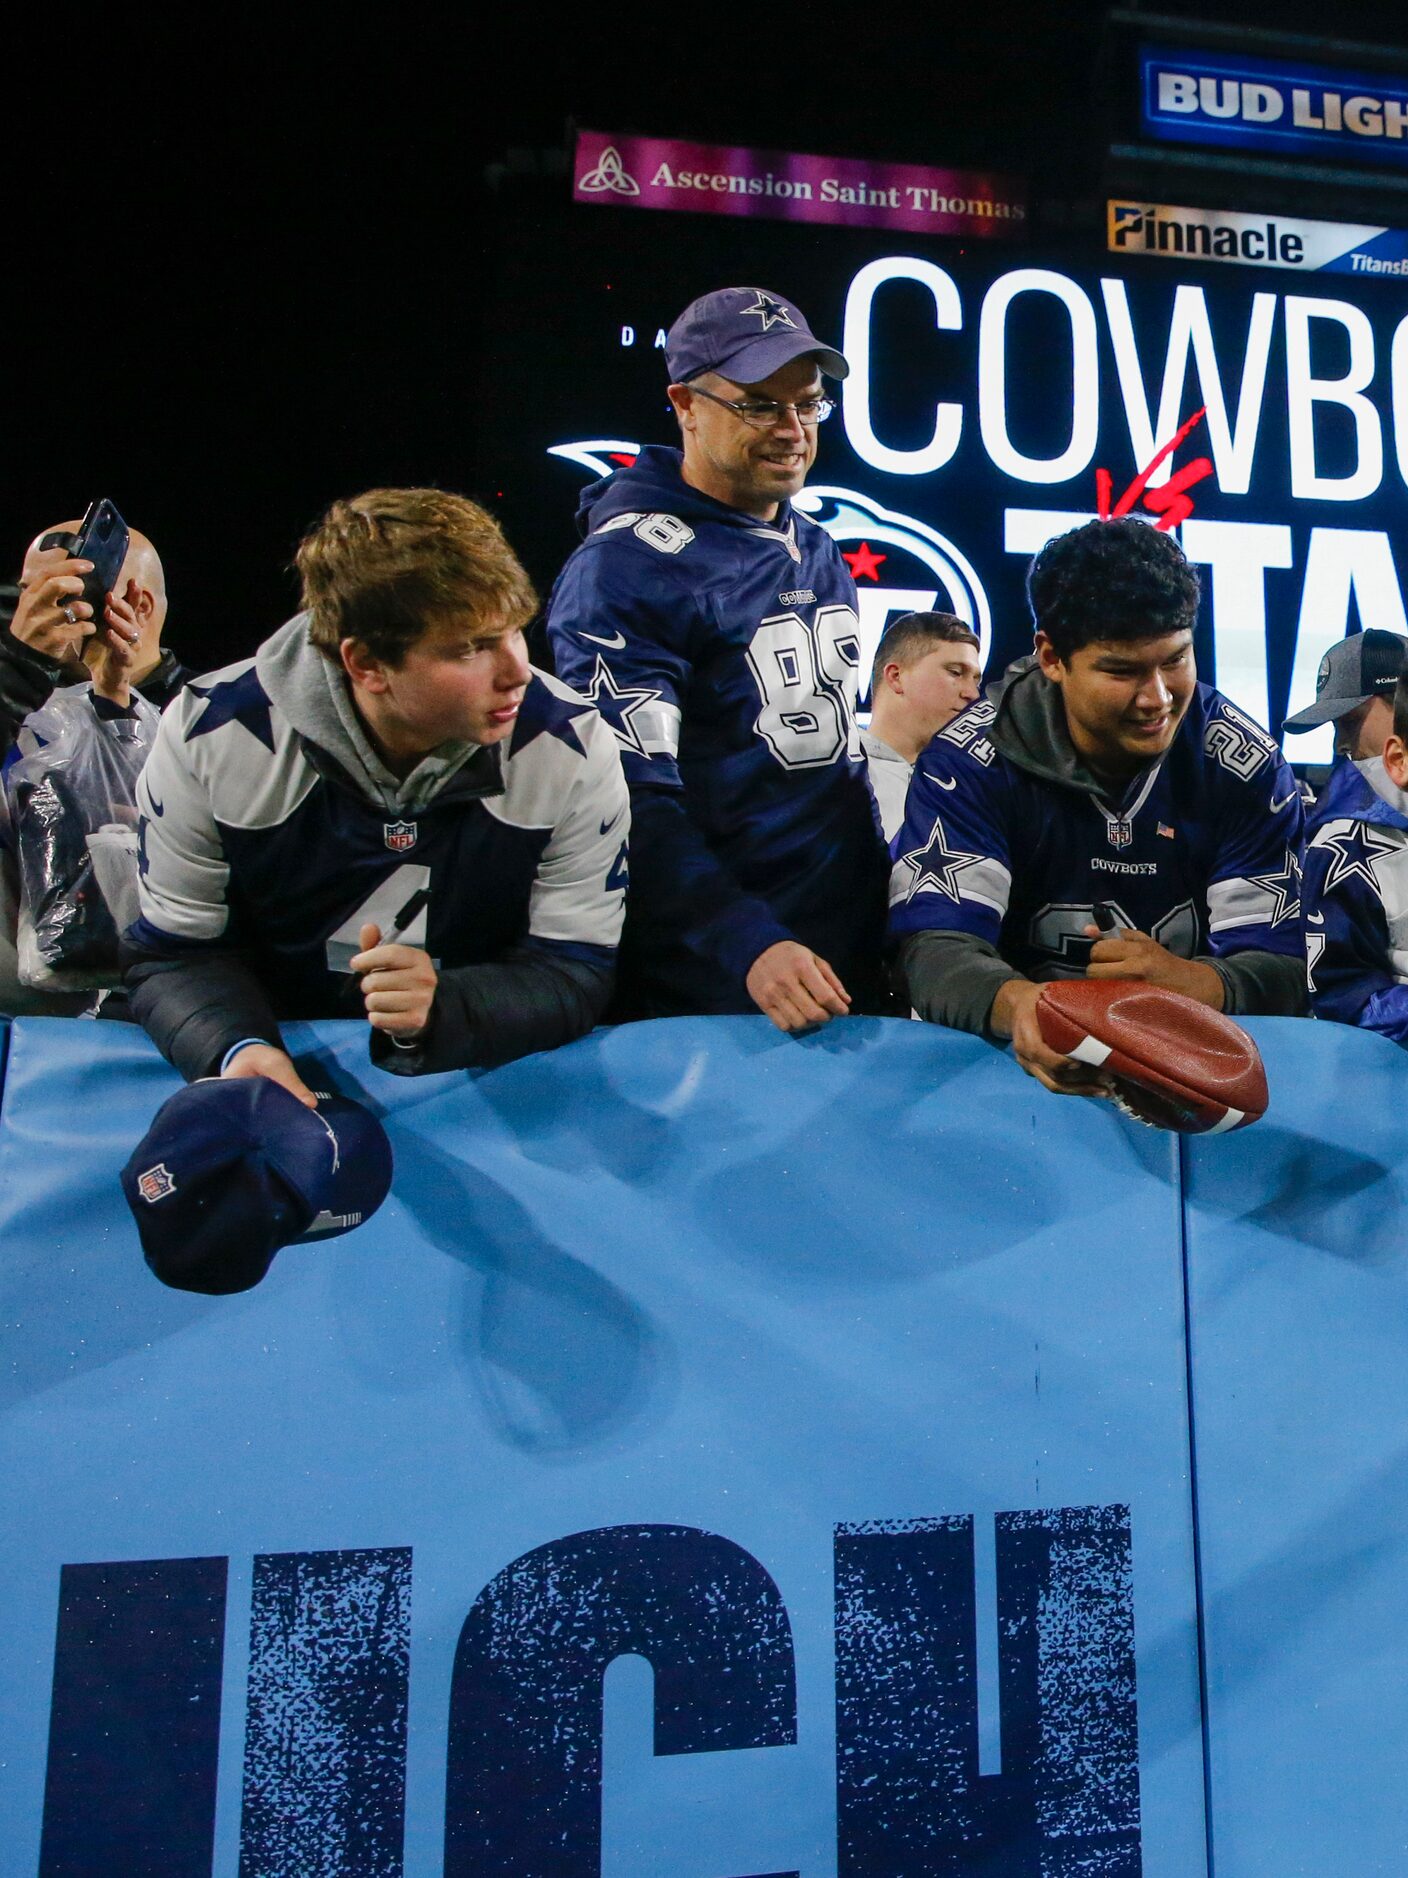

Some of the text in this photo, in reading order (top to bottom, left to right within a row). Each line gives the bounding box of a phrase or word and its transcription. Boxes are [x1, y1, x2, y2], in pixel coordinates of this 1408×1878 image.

[1157, 72, 1284, 123] BUD
[651, 162, 1026, 222] Ascension Saint Thomas
[1114, 206, 1304, 264] Pinnacle
[1204, 703, 1281, 782] 21
[387, 833, 414, 849] NFL
[1091, 857, 1158, 875] COWBOYS
